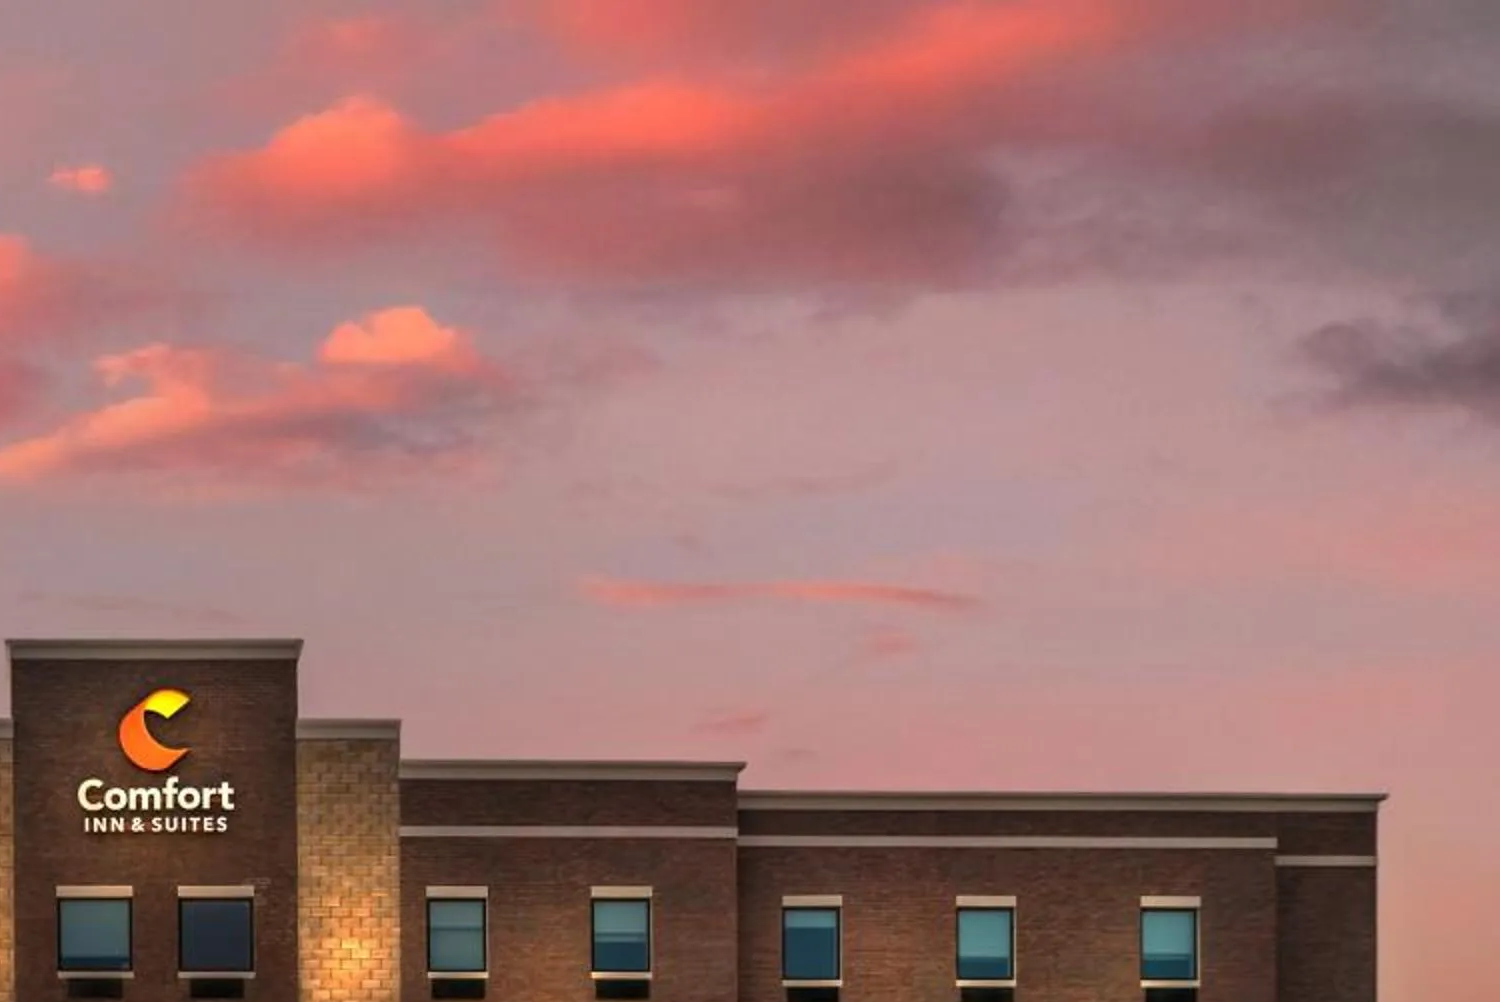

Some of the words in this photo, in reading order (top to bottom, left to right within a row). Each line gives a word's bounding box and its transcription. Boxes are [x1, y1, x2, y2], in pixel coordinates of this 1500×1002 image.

[77, 776, 235, 811] Comfort
[84, 817, 125, 832] INN
[131, 817, 145, 832] &
[151, 816, 228, 832] SUITES
